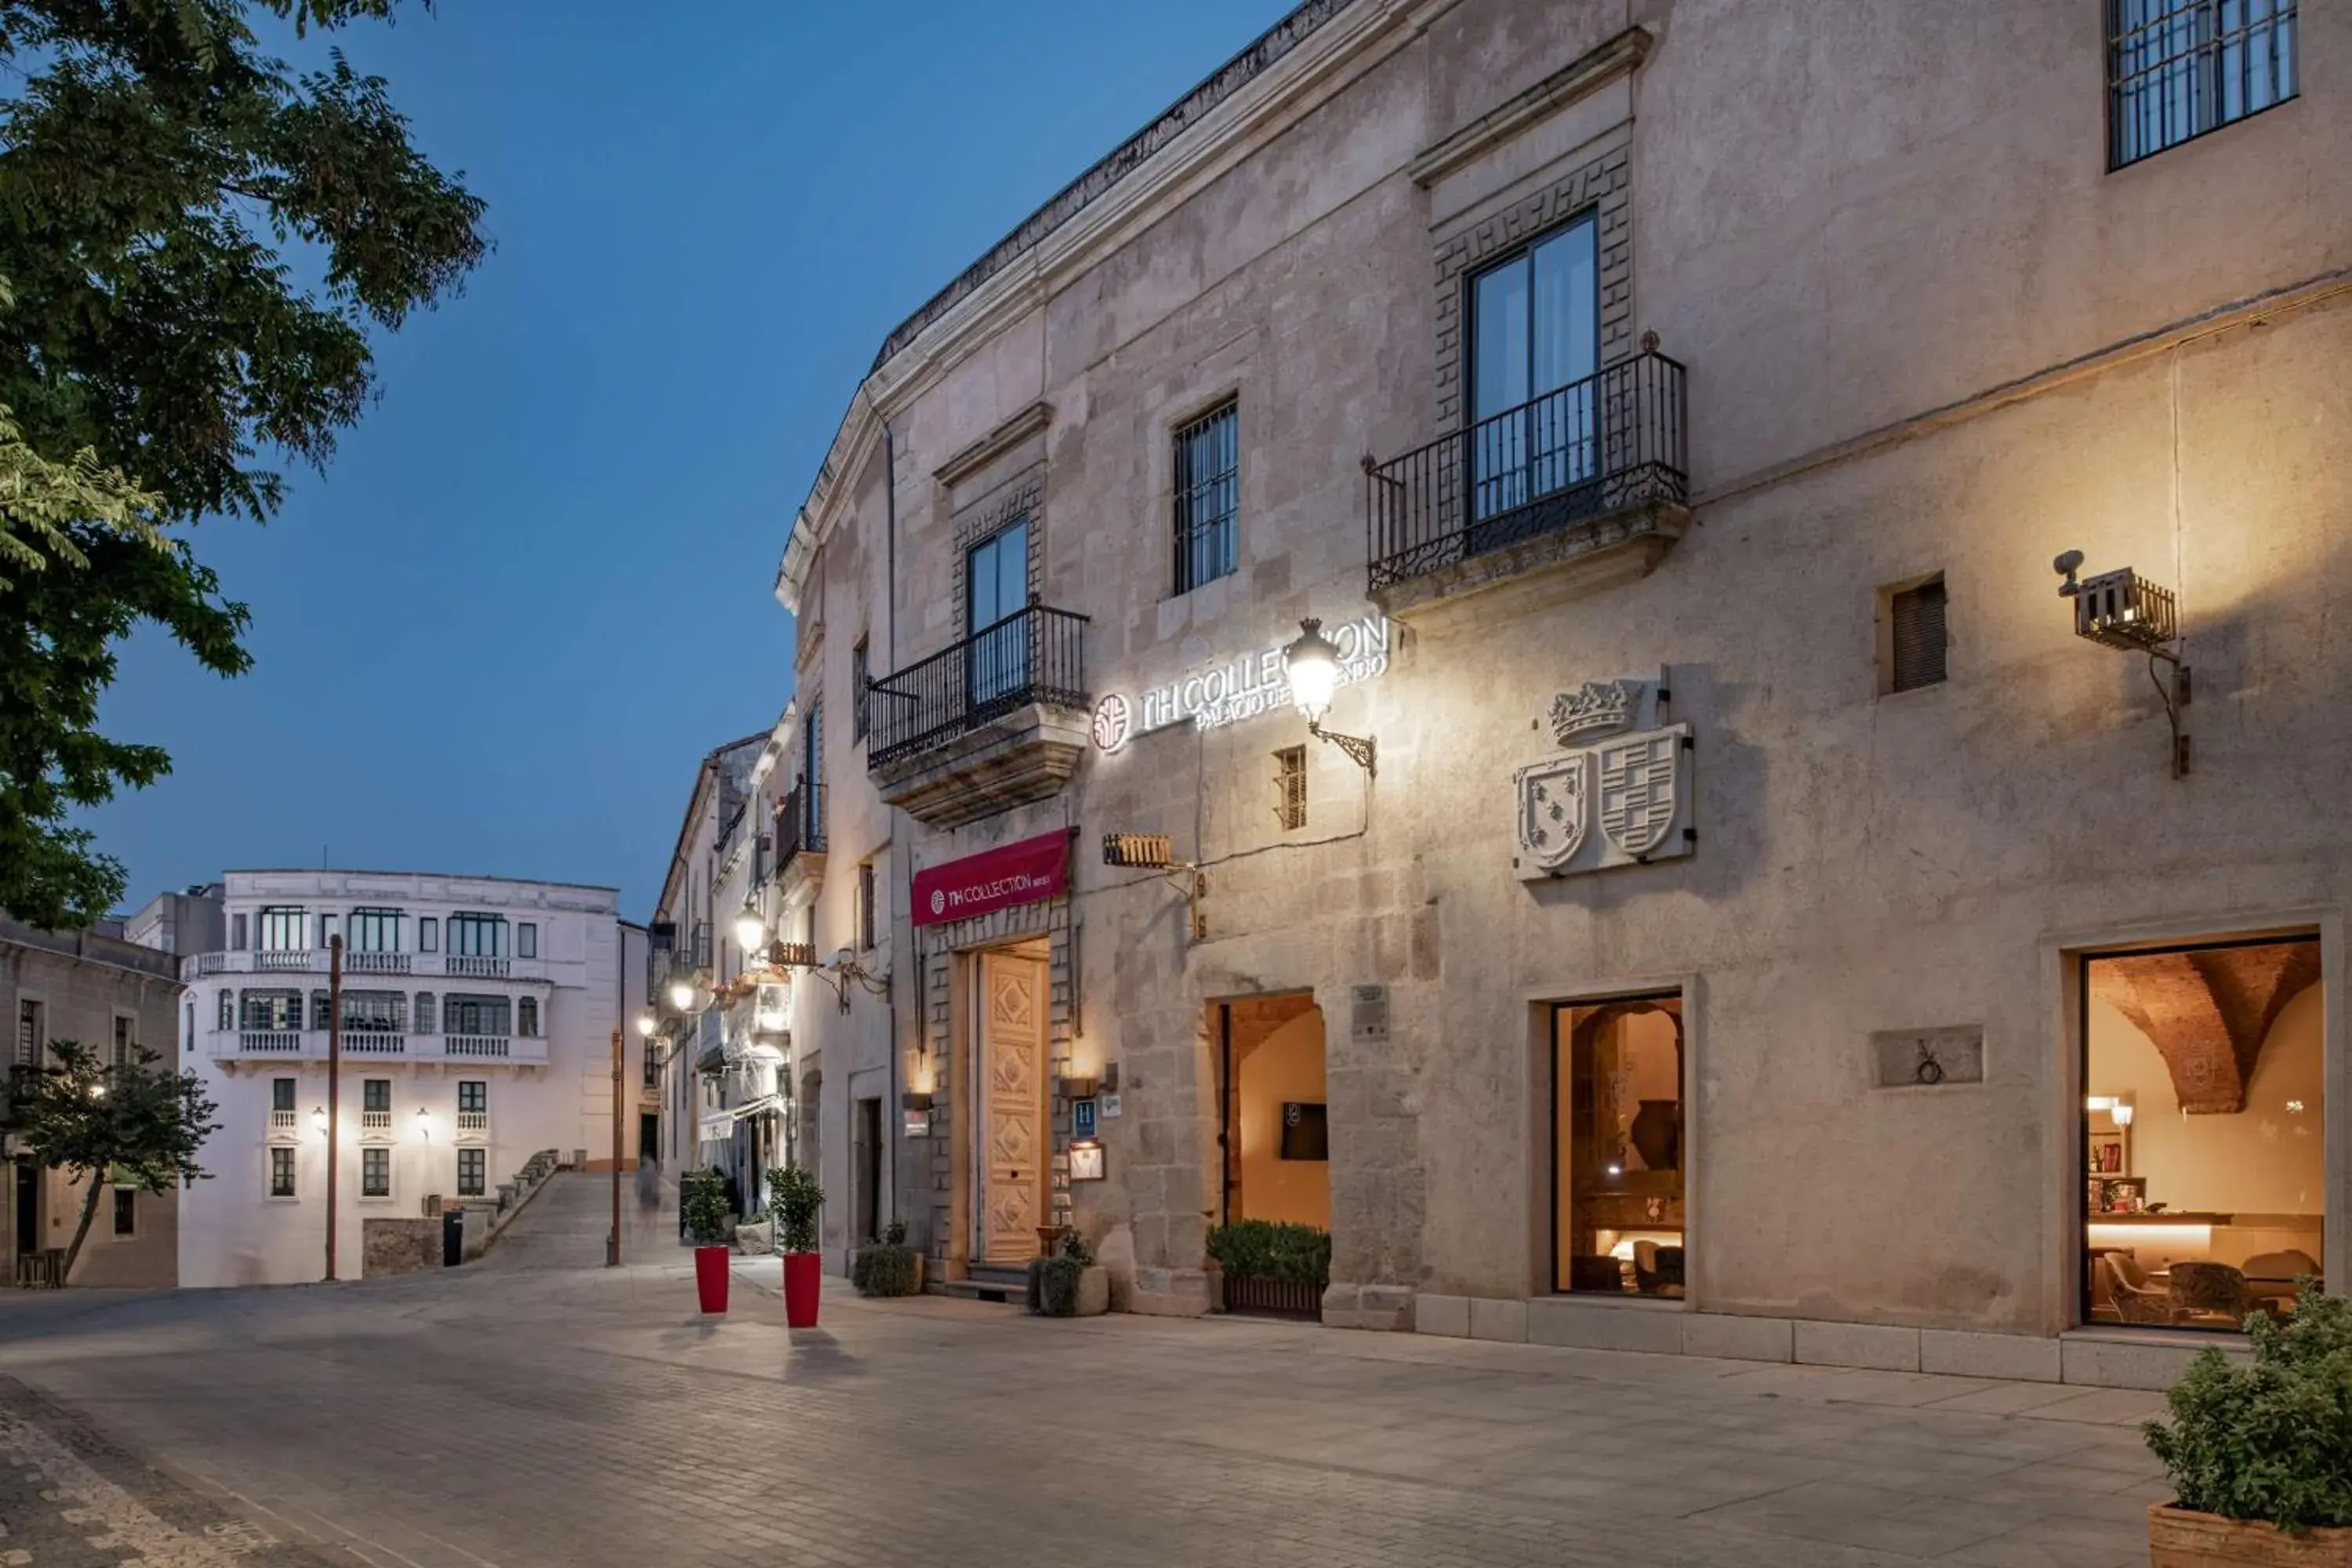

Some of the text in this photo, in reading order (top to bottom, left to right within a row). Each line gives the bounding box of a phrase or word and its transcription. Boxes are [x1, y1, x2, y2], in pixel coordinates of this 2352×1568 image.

[1195, 693, 1265, 732] PALACIO
[964, 873, 1031, 902] COLLECTION
[1079, 1104, 1091, 1123] H
